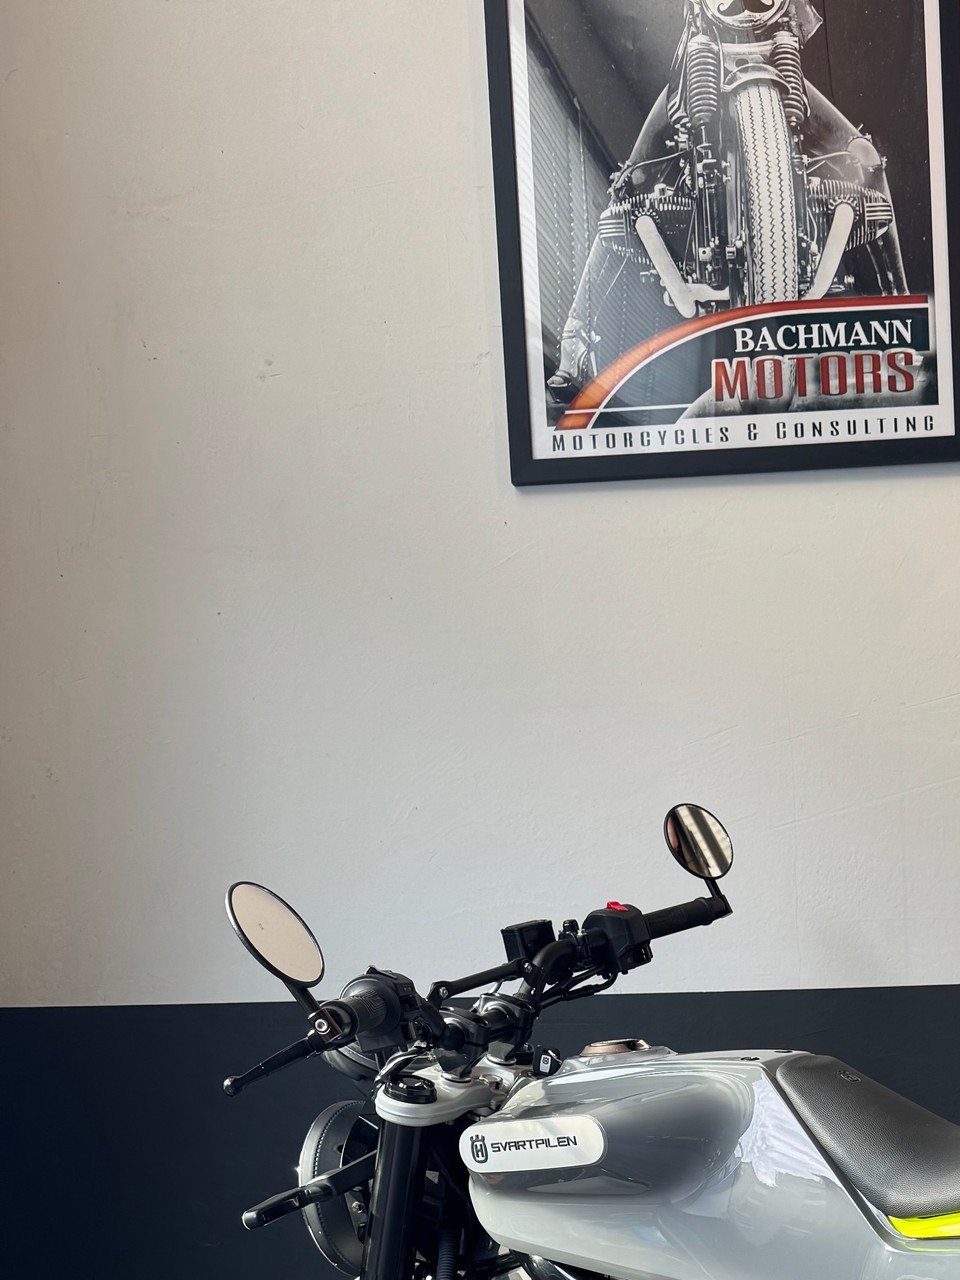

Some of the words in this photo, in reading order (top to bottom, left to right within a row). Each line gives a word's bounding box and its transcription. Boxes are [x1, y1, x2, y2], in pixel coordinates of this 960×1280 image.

[734, 319, 913, 353] BACHMANN
[713, 349, 917, 402] MOTORS
[552, 426, 730, 452] MOTORCYCLES
[747, 423, 759, 441] &
[776, 415, 935, 440] CONSULTING
[490, 1135, 578, 1153] SVARTPILEN
